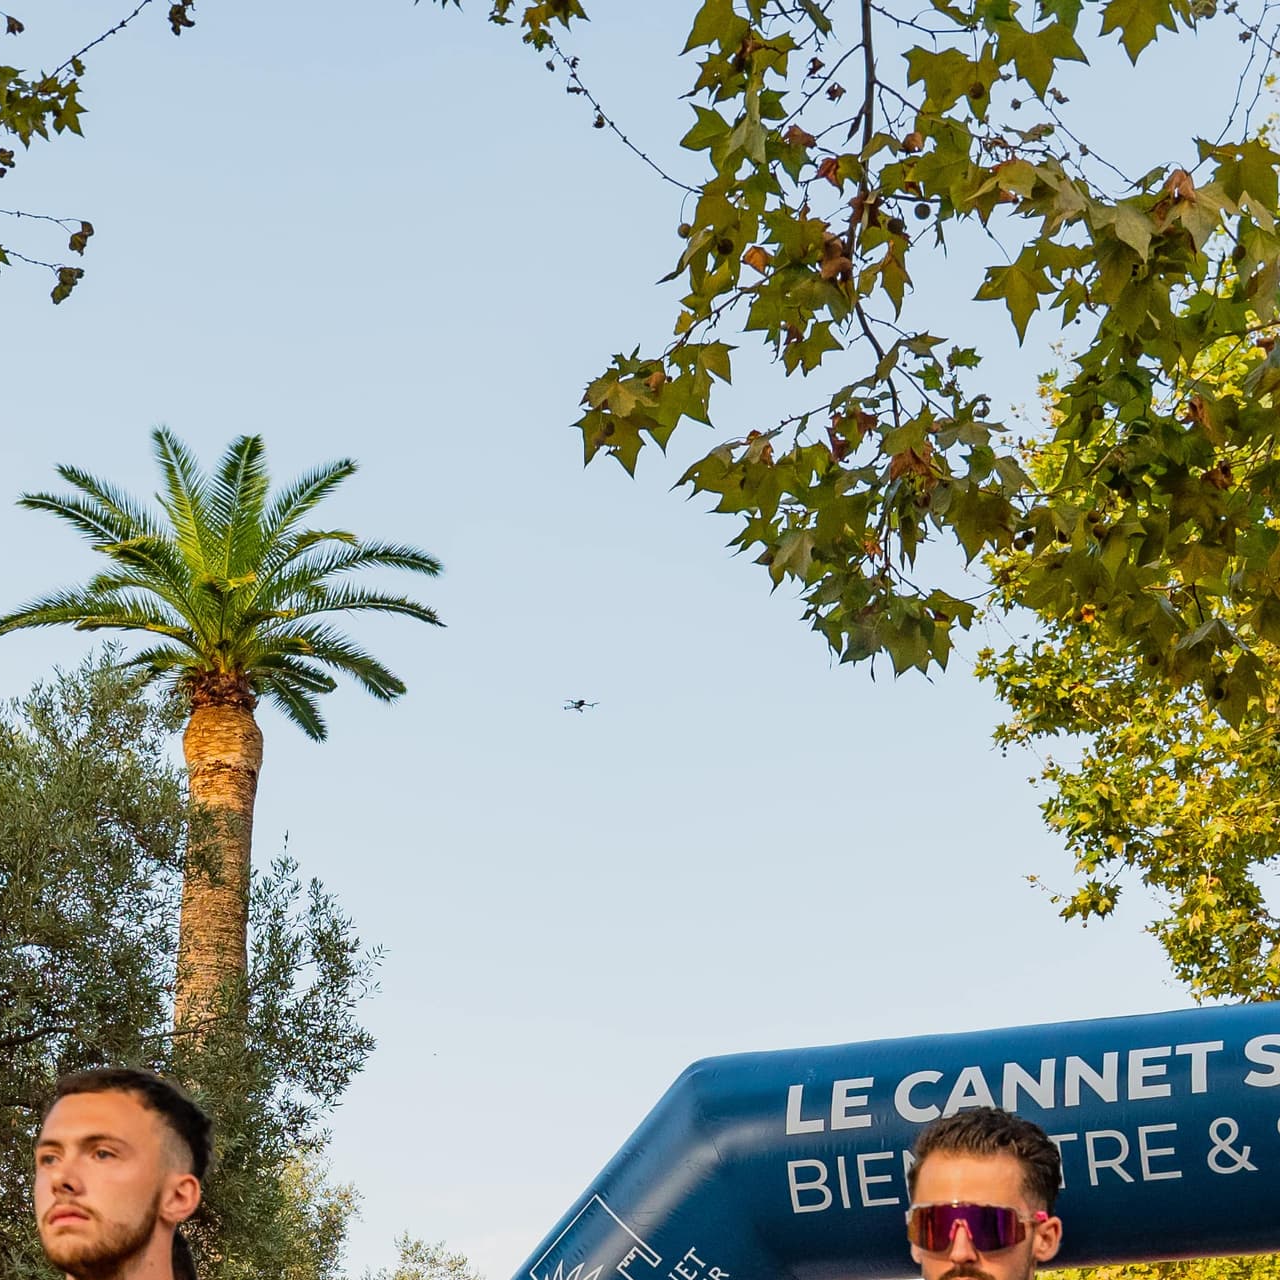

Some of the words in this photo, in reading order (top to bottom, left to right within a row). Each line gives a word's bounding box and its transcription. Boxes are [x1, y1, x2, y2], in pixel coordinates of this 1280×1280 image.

[785, 1077, 874, 1136] LE
[893, 1040, 1224, 1123] CANNET
[1206, 1116, 1259, 1175] &
